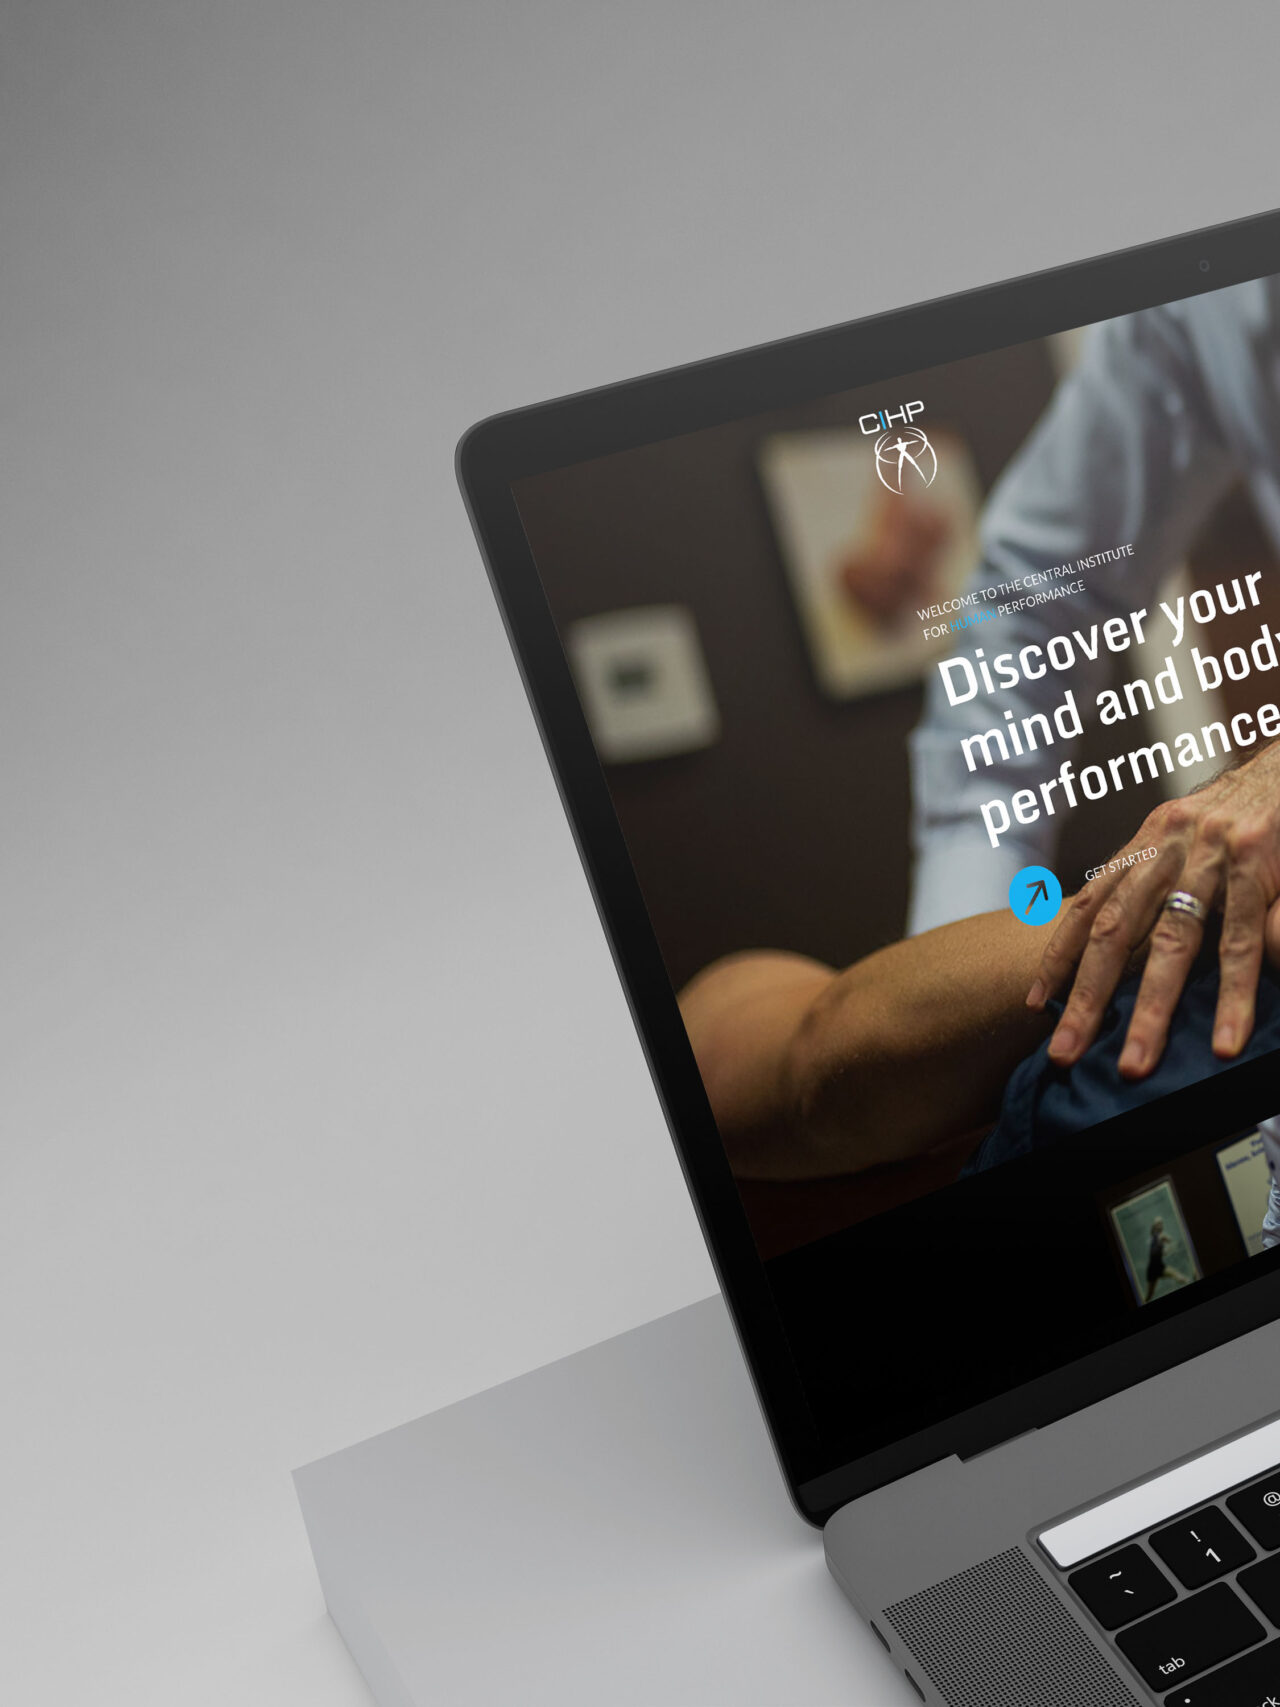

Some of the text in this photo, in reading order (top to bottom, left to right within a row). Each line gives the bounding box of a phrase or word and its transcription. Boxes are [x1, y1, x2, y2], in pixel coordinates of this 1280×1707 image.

[858, 400, 925, 435] CIHP
[916, 544, 1135, 622] WELCOME TO THE CENTRAL INSTITUTE
[923, 580, 1086, 641] FOR HUMAN PERFORMANCE
[937, 570, 1263, 707] Discover your
[960, 689, 1084, 772] mind
[1095, 655, 1184, 726] and
[1085, 846, 1158, 882] GET STARTED
[1263, 1492, 1280, 1506] @
[1189, 1530, 1202, 1543] !
[1206, 1548, 1221, 1562] 1
[1159, 1657, 1185, 1674] tab
